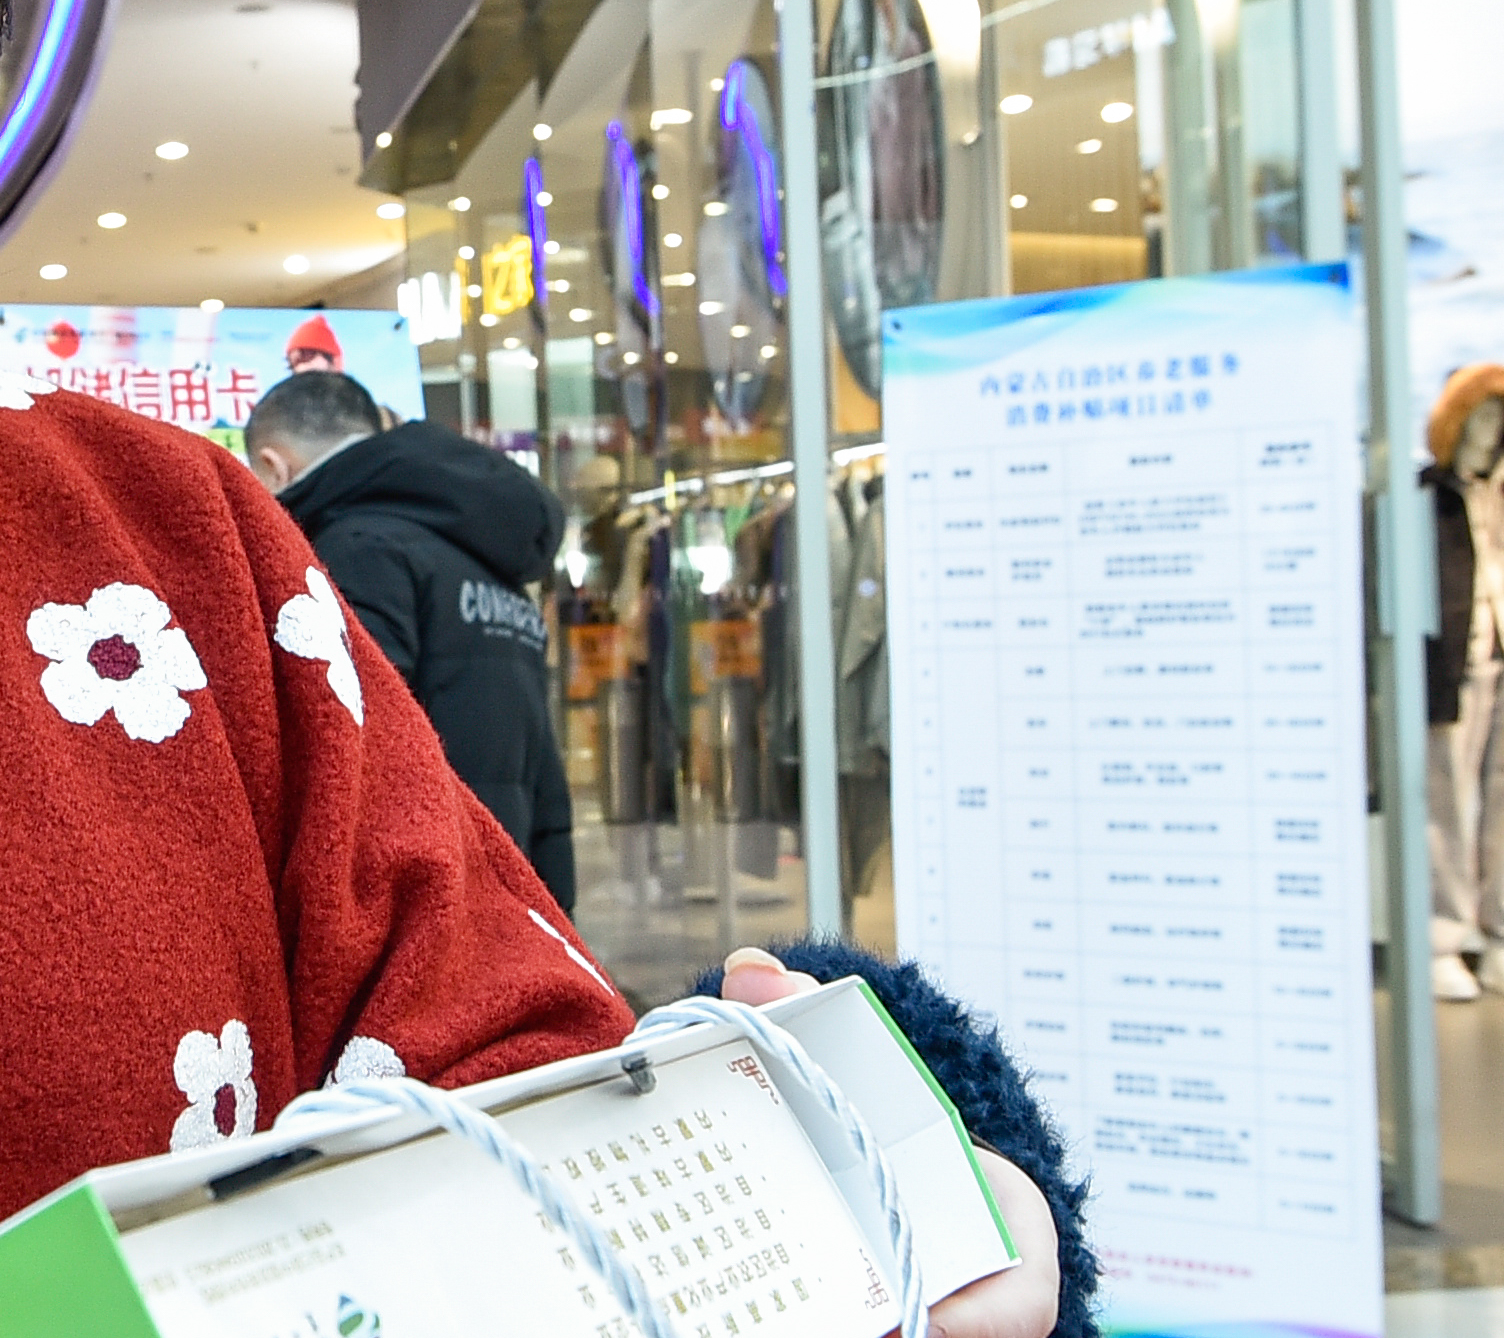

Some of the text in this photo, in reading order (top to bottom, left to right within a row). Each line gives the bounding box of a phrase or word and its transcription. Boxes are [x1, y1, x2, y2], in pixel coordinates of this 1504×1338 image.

[536, 1141, 733, 1234] 内蒙古味道生产业
[557, 1175, 752, 1271] 自治区专精特新业
